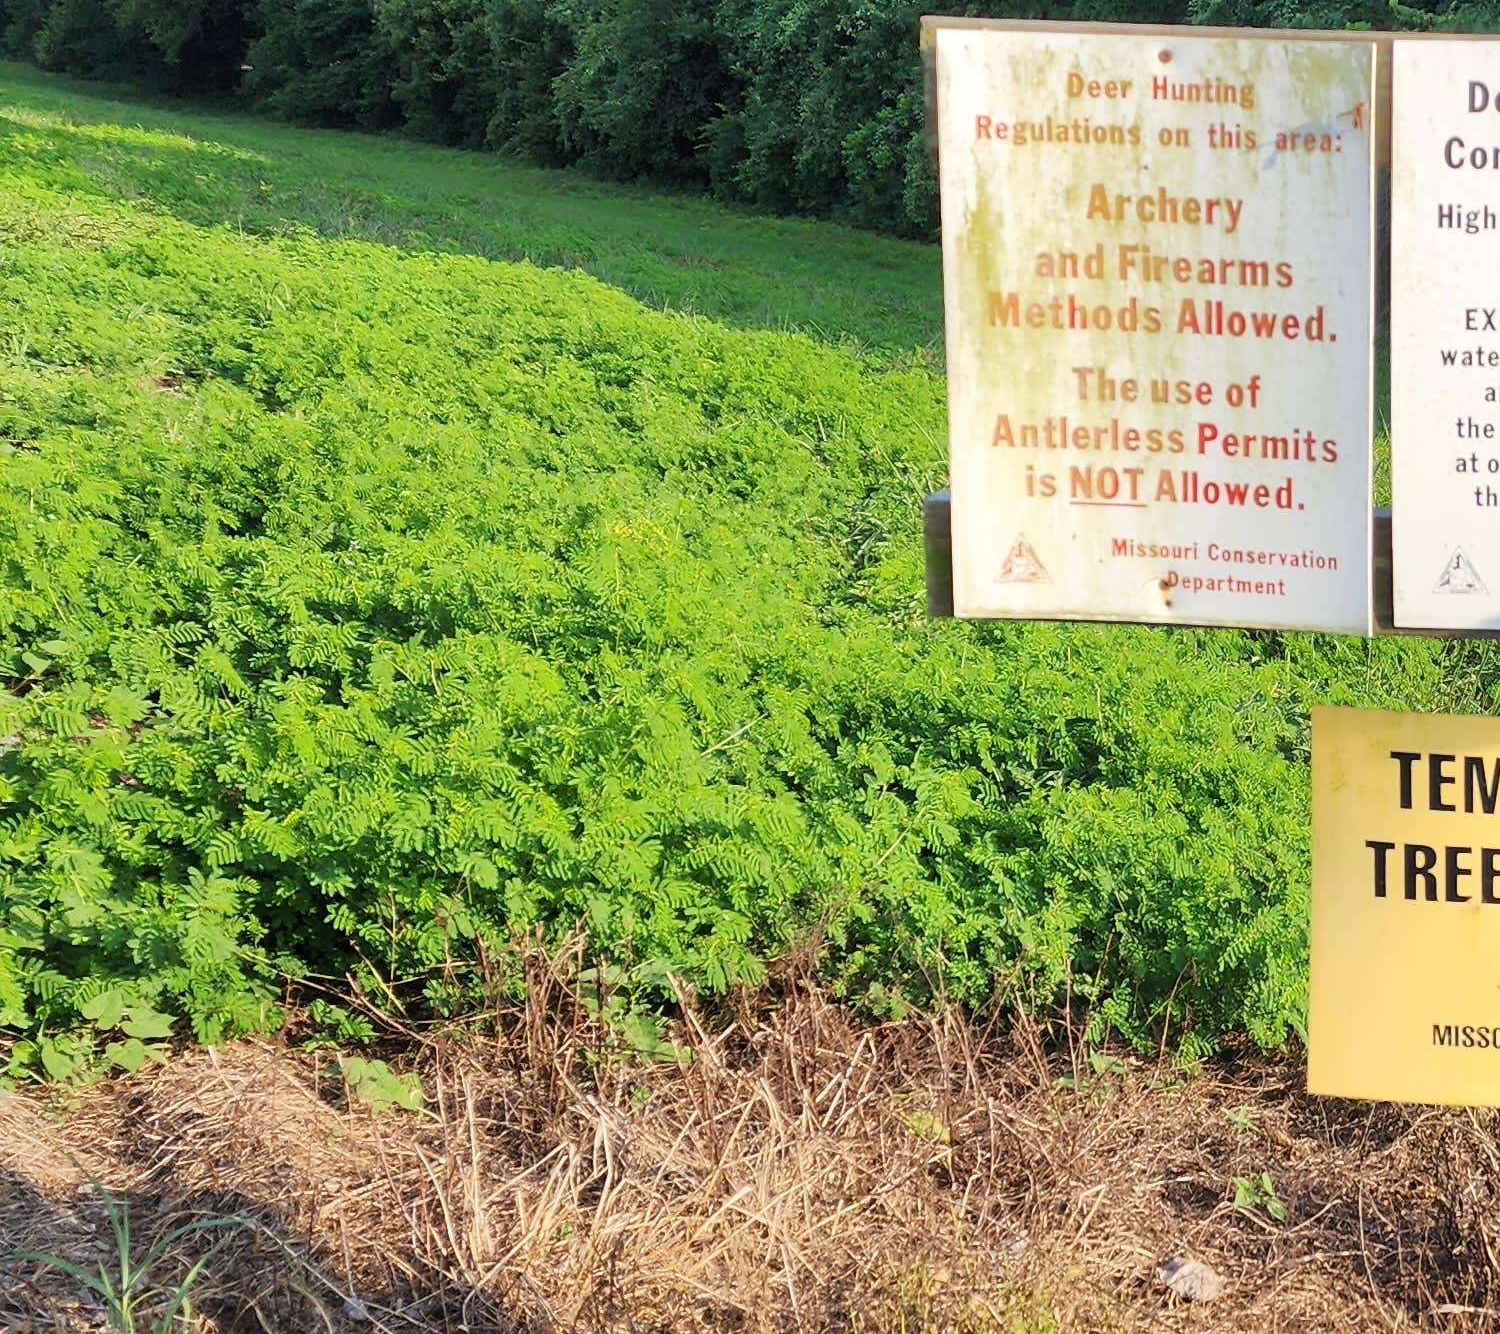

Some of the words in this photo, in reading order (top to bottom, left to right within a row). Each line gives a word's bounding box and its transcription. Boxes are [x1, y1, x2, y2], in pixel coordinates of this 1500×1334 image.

[1066, 72, 1132, 100] Deer
[1151, 75, 1255, 108] Hunting
[975, 115, 1141, 147] Regulations
[1158, 126, 1191, 149] on
[1208, 122, 1257, 150] this
[1275, 130, 1343, 153] area:
[1086, 183, 1244, 234] Archery
[1437, 205, 1497, 234] High
[1035, 244, 1104, 280] and
[1119, 245, 1294, 288] Firearms
[988, 292, 1162, 333] Methods
[1176, 298, 1338, 343] Allowed.
[1072, 366, 1138, 402] The
[1151, 377, 1212, 405] use
[1225, 375, 1261, 407] of
[991, 415, 1185, 454] Antlerless
[1198, 423, 1339, 463] Permits
[1456, 416, 1495, 439] the
[1455, 454, 1483, 474] at
[1025, 466, 1056, 499] is
[1068, 467, 1145, 501] NOT
[1155, 467, 1305, 511] Allowed.
[1111, 538, 1199, 561] Missouri
[1208, 542, 1339, 571] Conservation
[1167, 570, 1286, 596] Department
